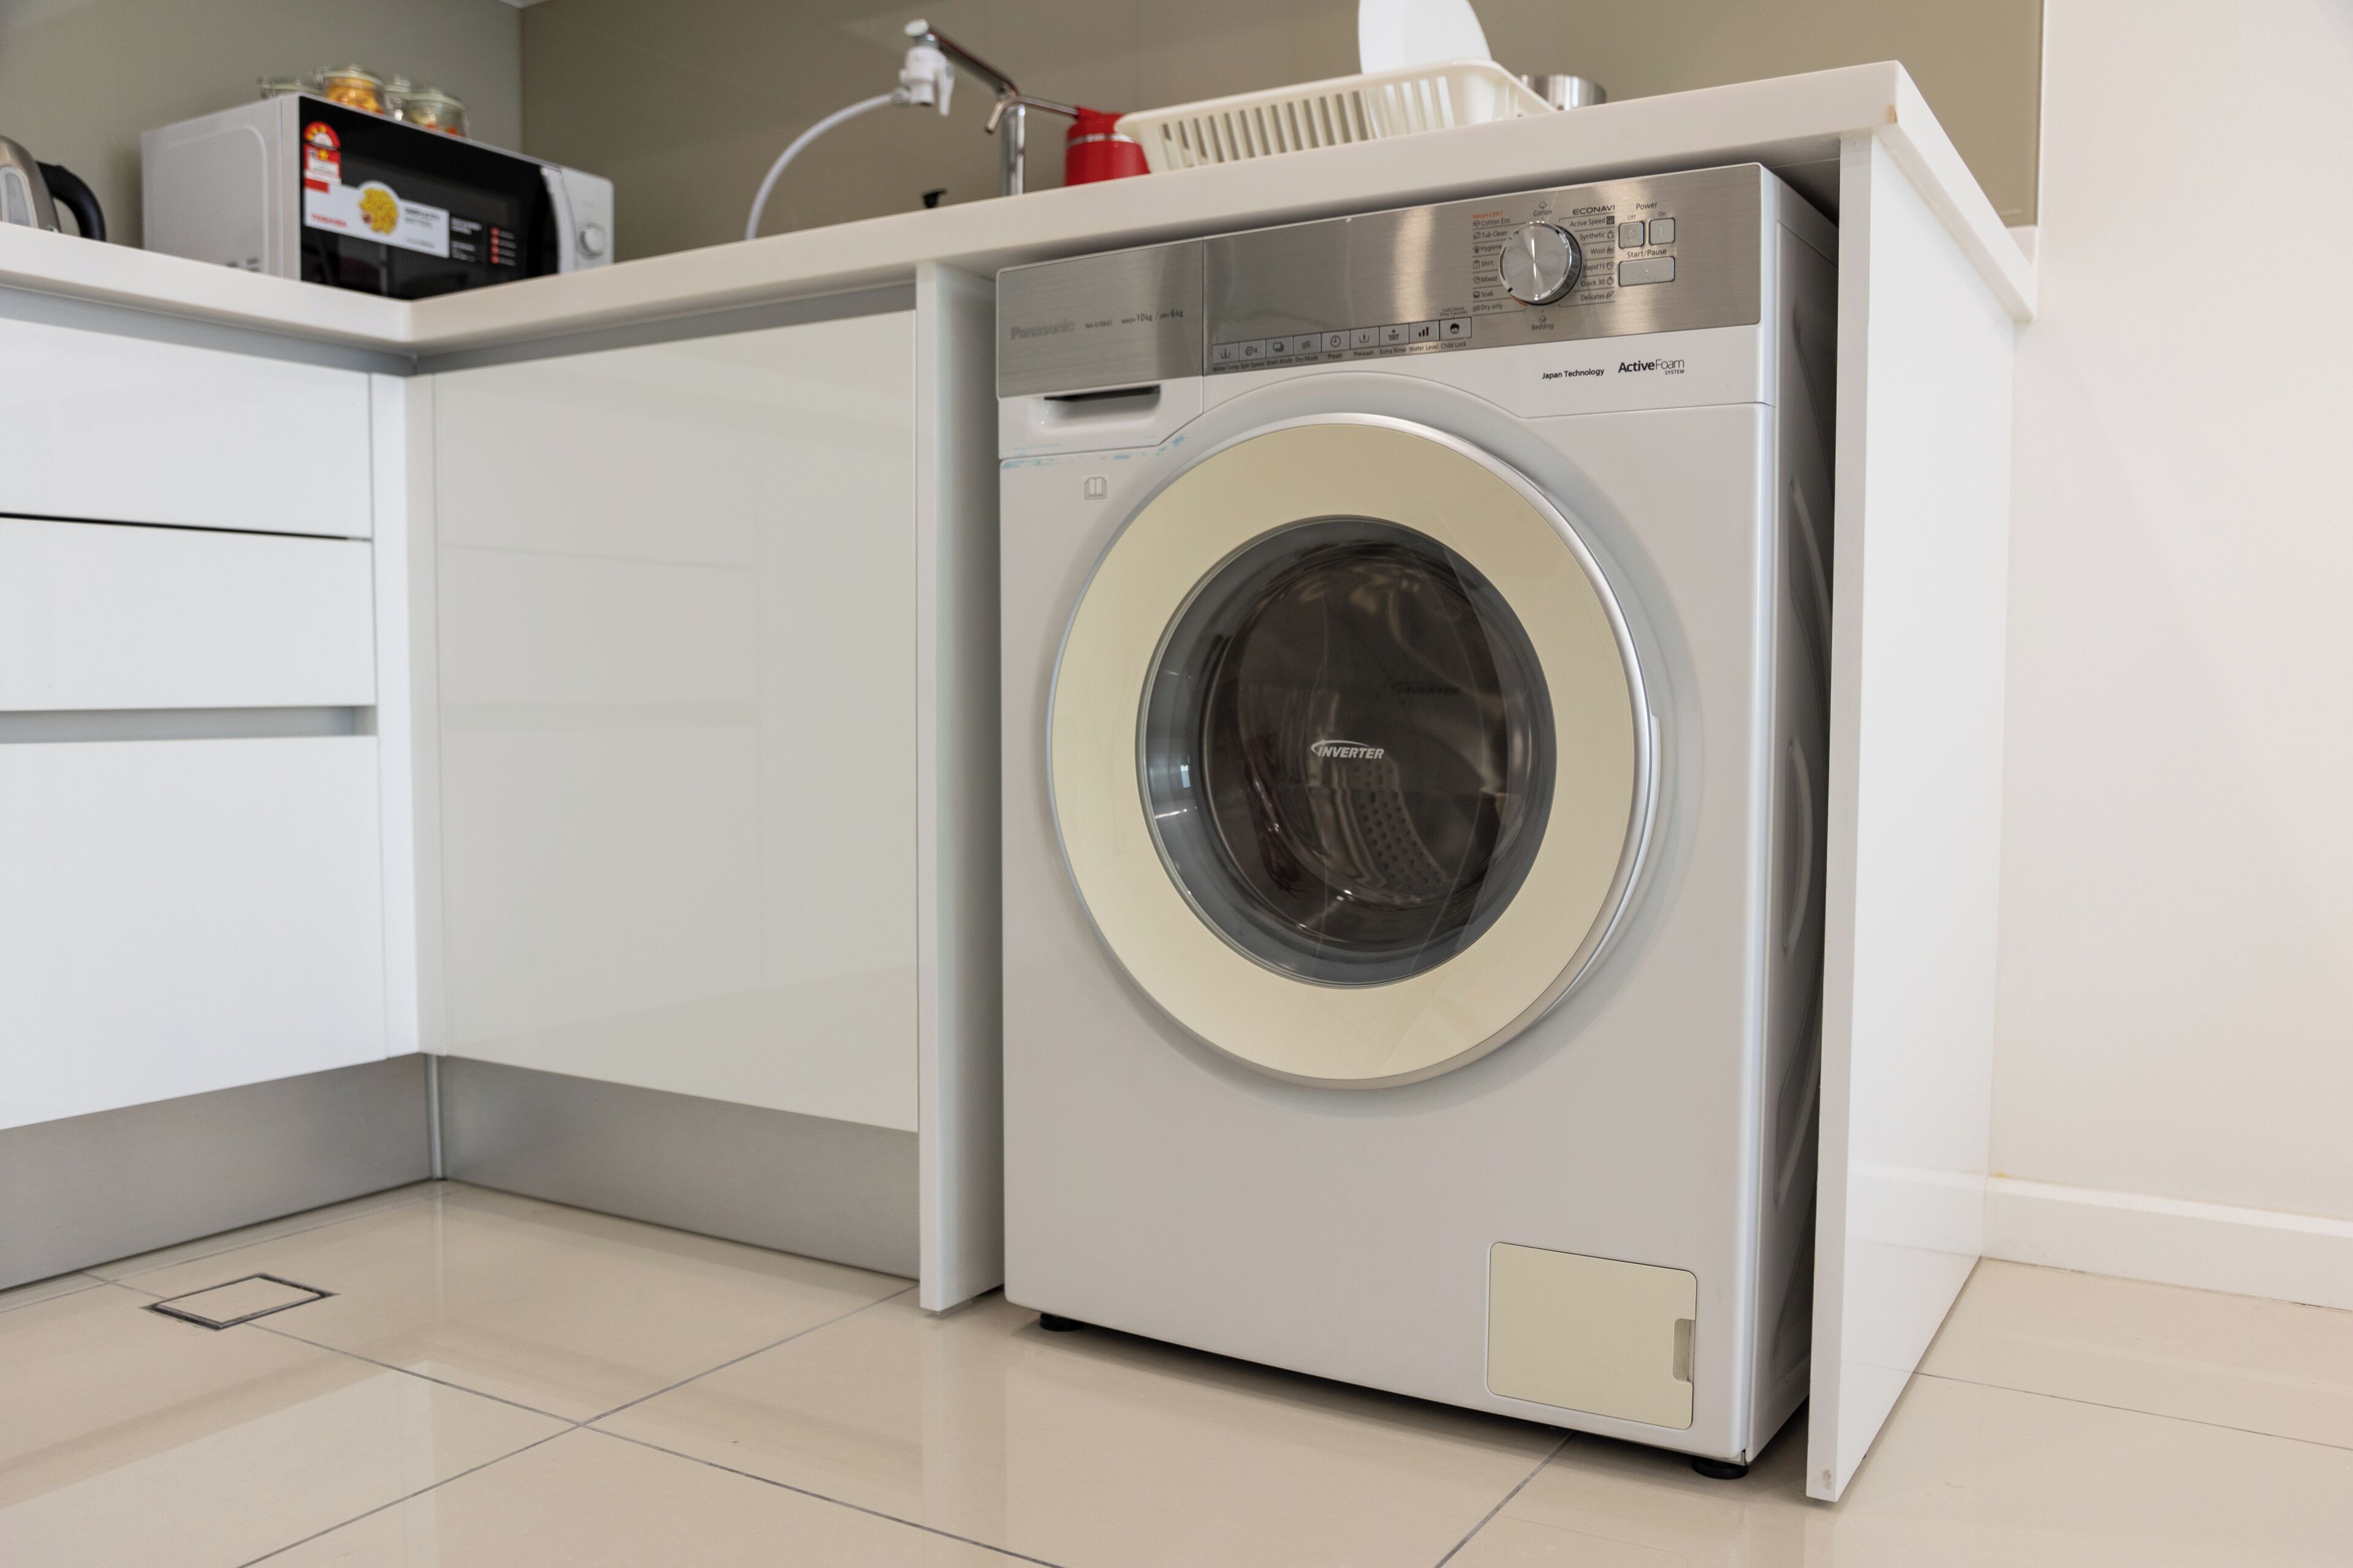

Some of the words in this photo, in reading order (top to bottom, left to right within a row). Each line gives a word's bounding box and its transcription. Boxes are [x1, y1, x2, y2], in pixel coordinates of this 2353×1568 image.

[1572, 205, 1615, 215] ECONAVI
[1588, 217, 1605, 226] Speed
[1580, 231, 1605, 241] Synthetic
[1627, 249, 1667, 259] Start/Pause
[1584, 263, 1599, 271] Rapid
[1011, 319, 1075, 339] Panasonic
[1542, 371, 1563, 380] Japan
[1564, 368, 1605, 377] Technology
[1316, 743, 1385, 759] INVERTER
